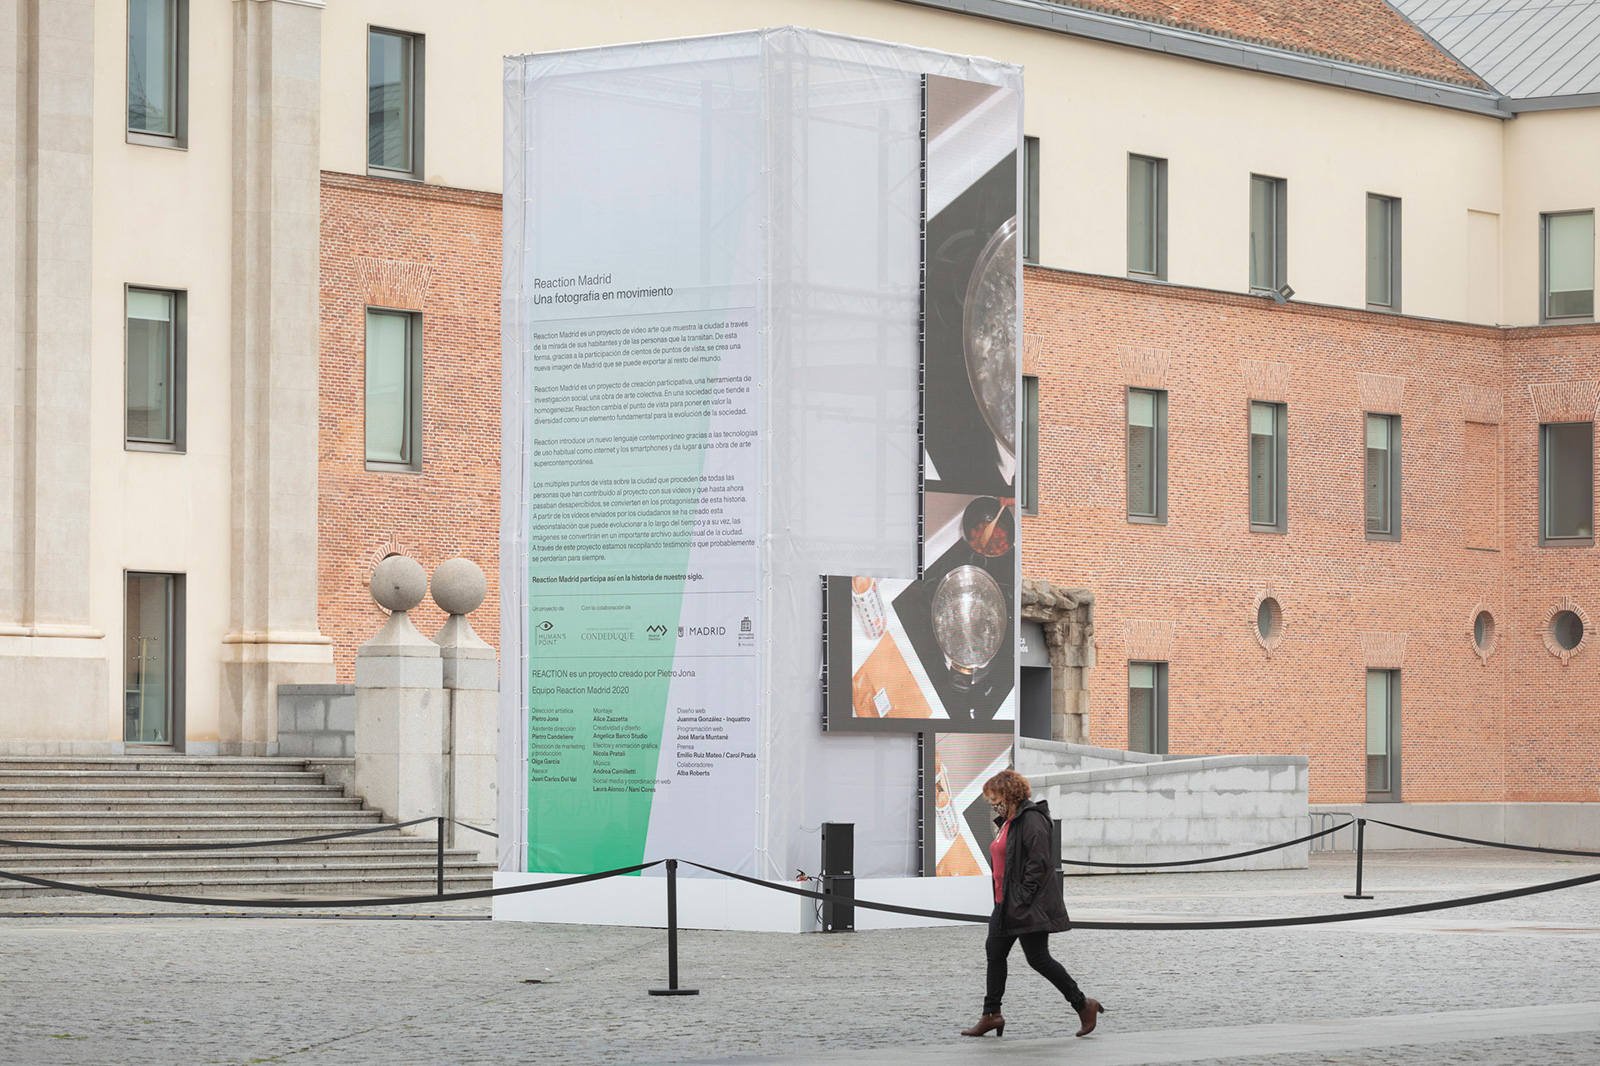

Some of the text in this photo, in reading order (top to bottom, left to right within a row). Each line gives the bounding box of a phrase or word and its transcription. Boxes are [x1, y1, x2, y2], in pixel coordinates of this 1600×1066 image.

[534, 273, 611, 289] Reaction Madrid
[534, 286, 673, 305] Una fotografía en movimiento
[623, 359, 641, 368] puede
[642, 358, 666, 366] exportar
[616, 412, 652, 420] fundamental
[674, 410, 702, 418] evolución
[613, 435, 638, 443] lenguaje
[639, 433, 685, 441] contemporáneo
[686, 432, 707, 441] gracias
[723, 430, 758, 438] tecnologías
[580, 575, 606, 583] participa
[687, 573, 704, 581] siglo.
[689, 627, 726, 635] MADRID
[581, 632, 634, 642] CONDEDUQUE
[531, 670, 568, 678] REACTION
[588, 670, 618, 679] proyecto
[657, 669, 677, 677] Pietro
[531, 686, 629, 695] Equipo Reaction Madrid 2020
